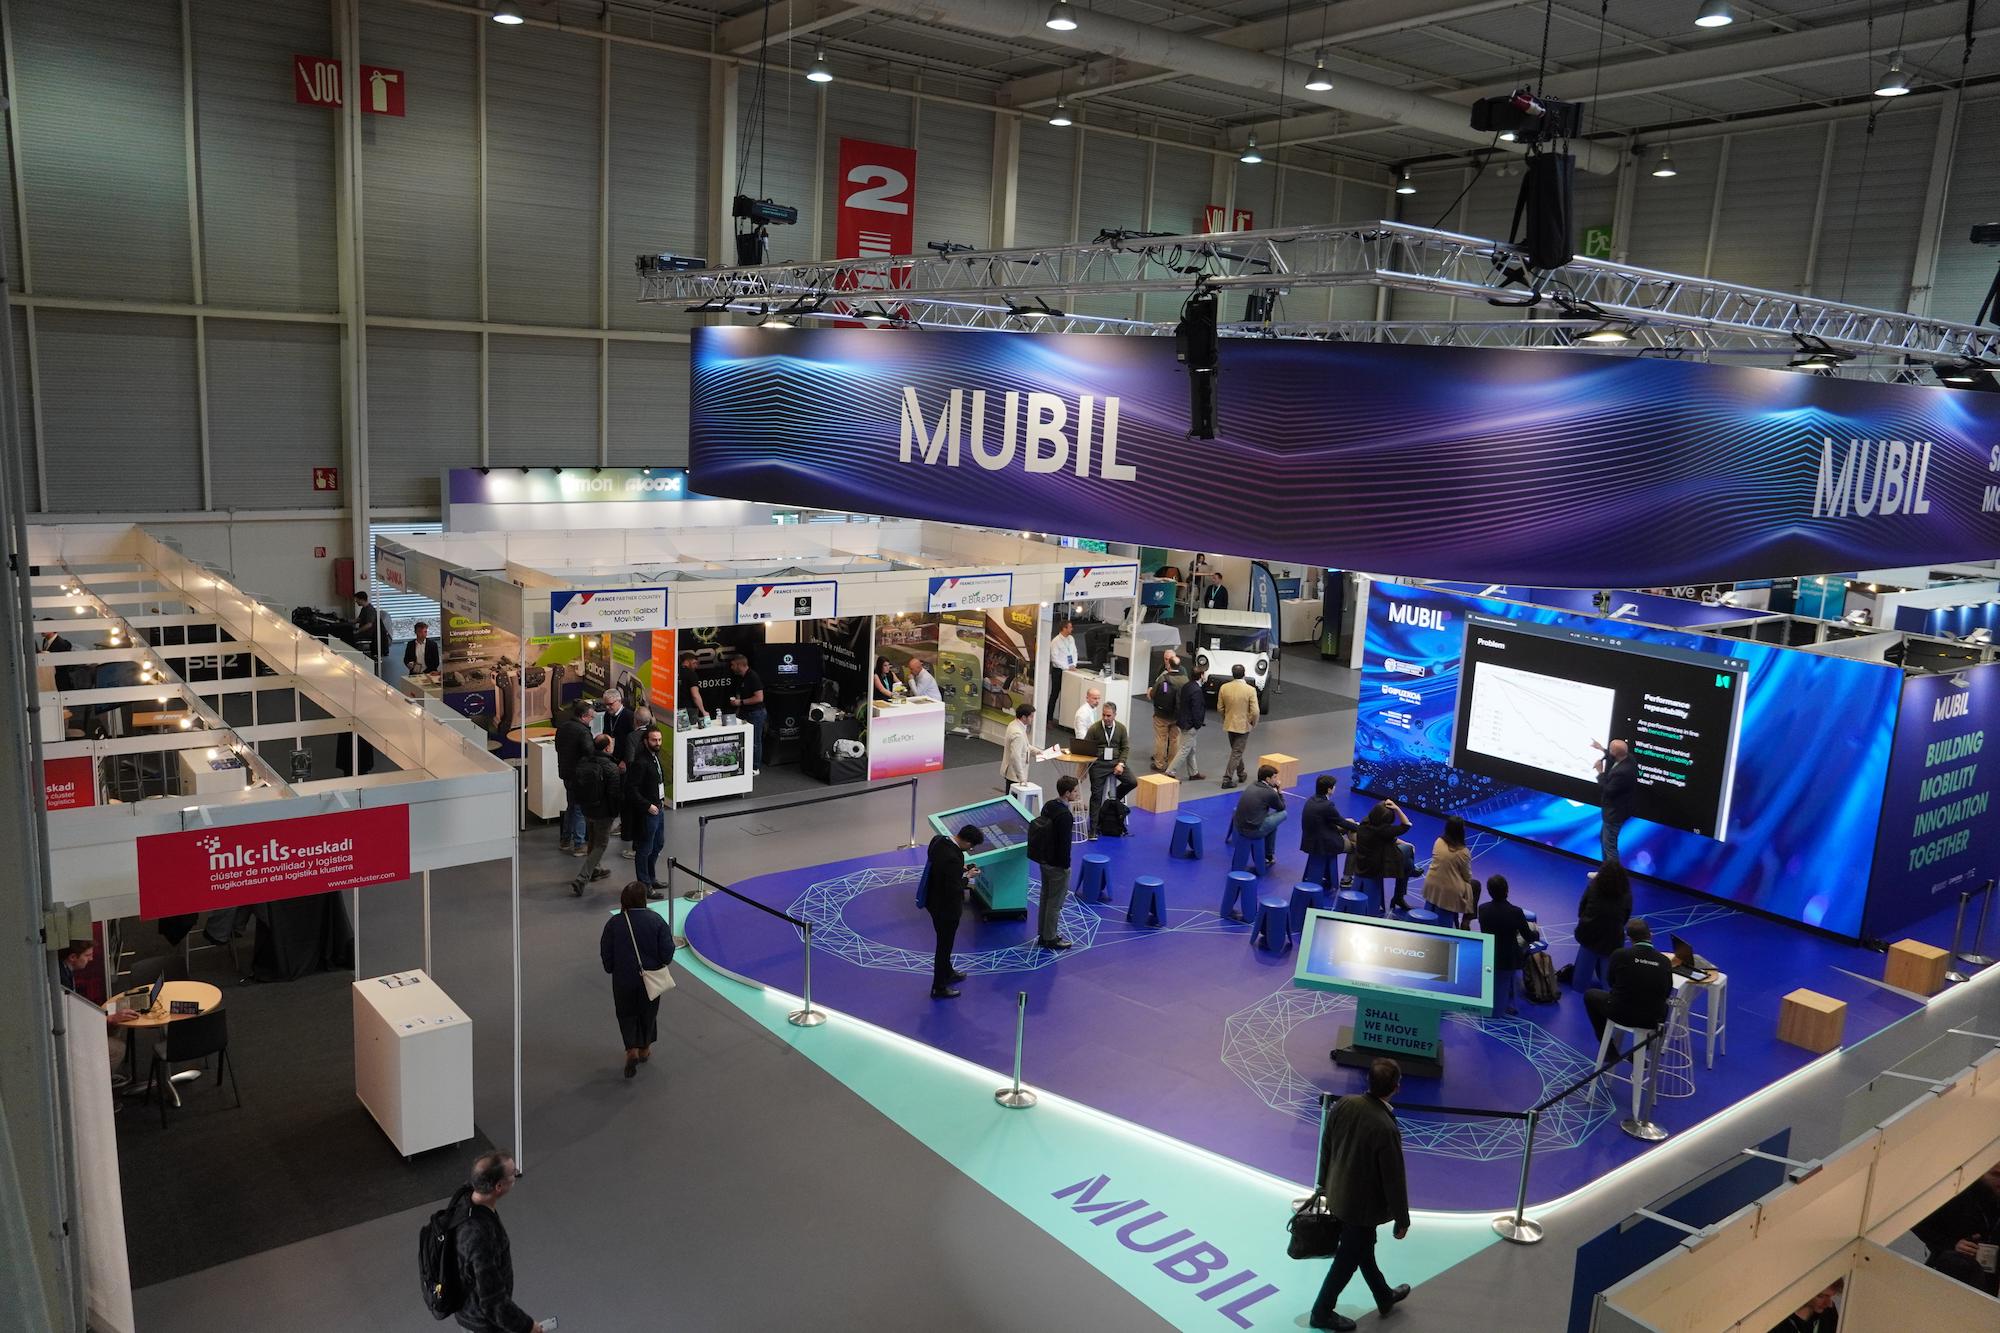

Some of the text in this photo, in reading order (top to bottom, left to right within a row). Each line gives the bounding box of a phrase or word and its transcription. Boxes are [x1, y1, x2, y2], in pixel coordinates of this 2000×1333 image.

[845, 165, 908, 215] 2
[899, 386, 1137, 481] MUBIL
[1812, 437, 1932, 518] MUBIL
[1671, 585, 1696, 598] we
[1389, 602, 1445, 631] MUBIL
[1477, 637, 1505, 650] Problem
[698, 677, 732, 689] RBOXES
[1644, 693, 1690, 710] Performance
[1644, 704, 1689, 719] repeatability
[1933, 692, 1969, 722] MUBIL
[1925, 730, 1984, 768] BUILDING
[1919, 764, 1977, 803] MOBILITY
[1913, 791, 1989, 838] INNOVATION
[1909, 829, 1970, 872] TOGETHER
[210, 869, 243, 882] clúster
[246, 867, 258, 877] de
[261, 859, 305, 874] movilidad
[307, 860, 314, 869] y
[210, 863, 353, 891] mugikortasun eta logistika klusterra
[327, 872, 395, 888] www.mlcluster.com
[1384, 945, 1425, 958] novac
[1364, 1008, 1400, 1021] SHALL
[1364, 1020, 1418, 1037] WE MOVE
[1363, 1032, 1433, 1051] THE FUTURE?
[1050, 1173, 1281, 1330] MUBIL
